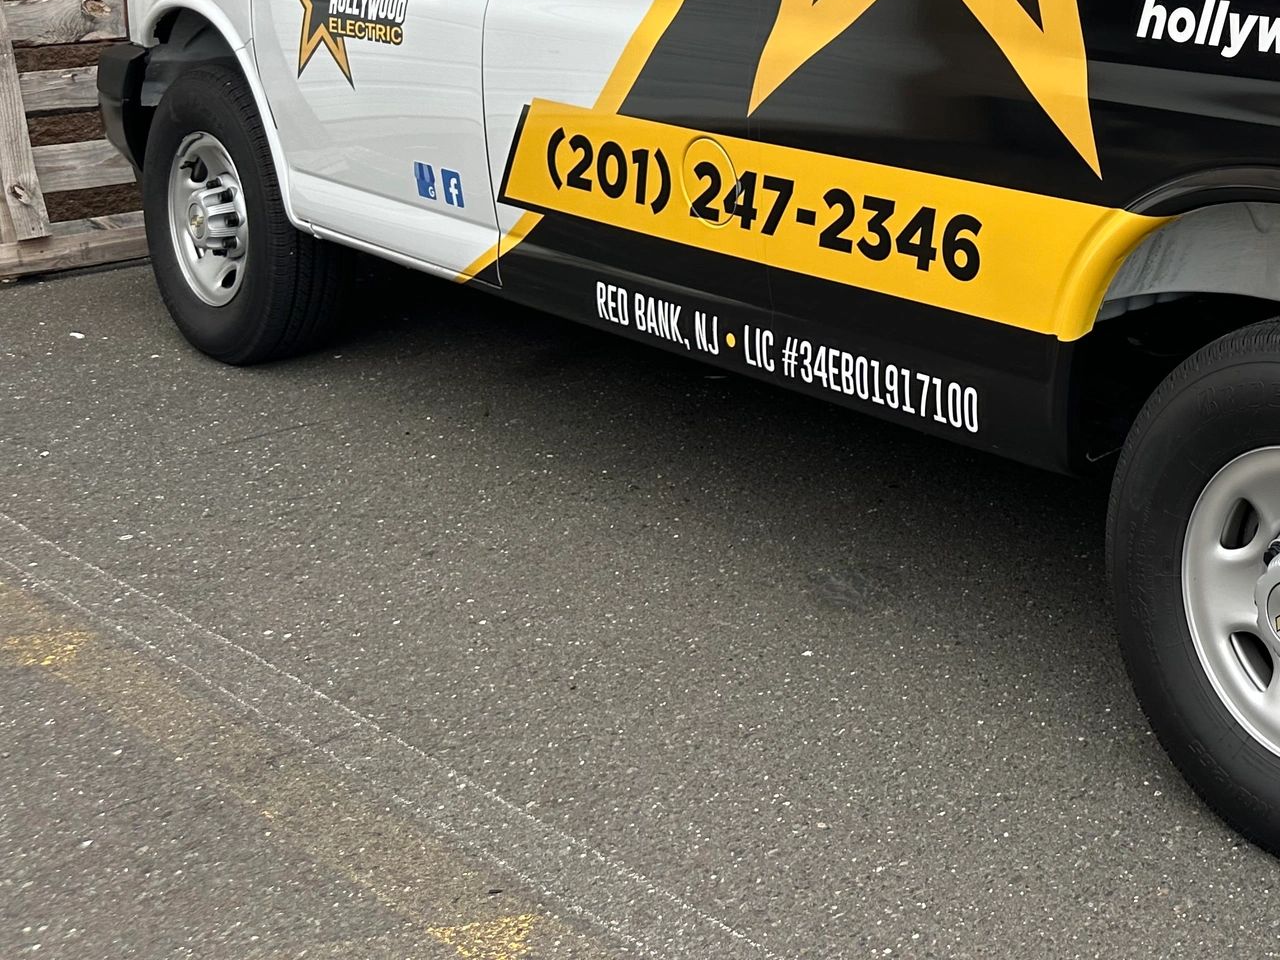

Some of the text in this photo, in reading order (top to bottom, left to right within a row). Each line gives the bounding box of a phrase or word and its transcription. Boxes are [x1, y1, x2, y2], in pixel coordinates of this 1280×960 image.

[328, 17, 403, 44] ELECTRIC
[546, 126, 984, 283] (201) 247-2346
[595, 280, 979, 435] RED BANK, NJ LIC #34EB01917100
